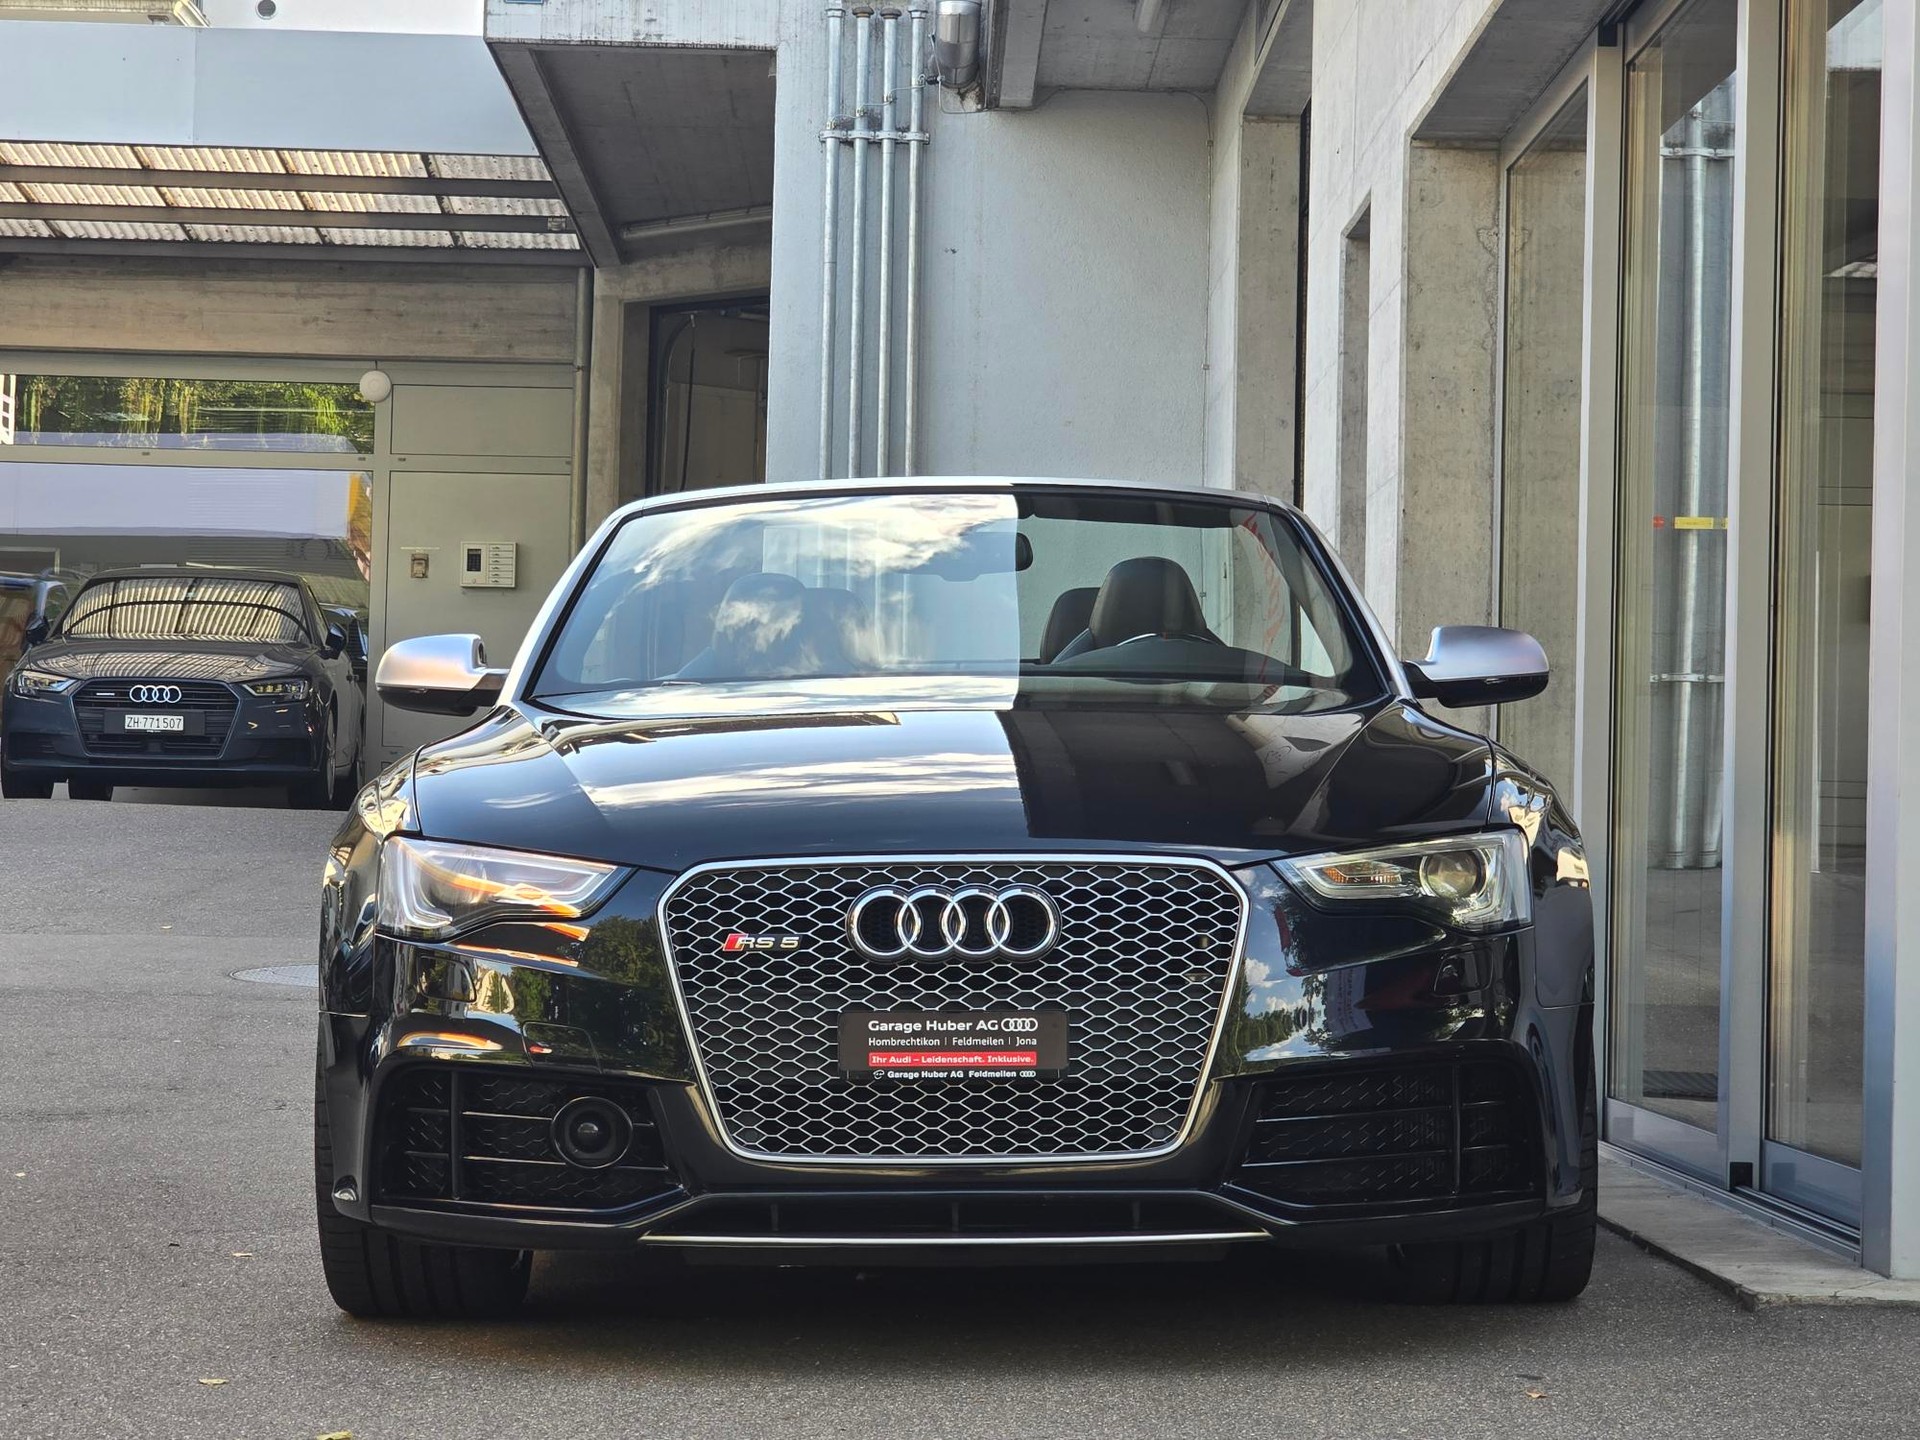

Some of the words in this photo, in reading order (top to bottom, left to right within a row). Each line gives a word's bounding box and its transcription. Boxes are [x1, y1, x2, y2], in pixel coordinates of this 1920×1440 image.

[735, 936, 775, 949] RS
[780, 936, 800, 949] 5
[868, 1020, 922, 1034] Garage
[926, 1020, 973, 1031] Huber
[976, 1020, 999, 1031] AG
[868, 1037, 940, 1046] Hombrechtikon
[952, 1037, 1004, 1046] Feldmeilen
[1016, 1037, 1037, 1046] Jona
[872, 1056, 887, 1064] Ihr
[889, 1056, 912, 1064] Audi
[921, 1056, 985, 1064] Leidenschaft.
[887, 1071, 919, 1079] Garage
